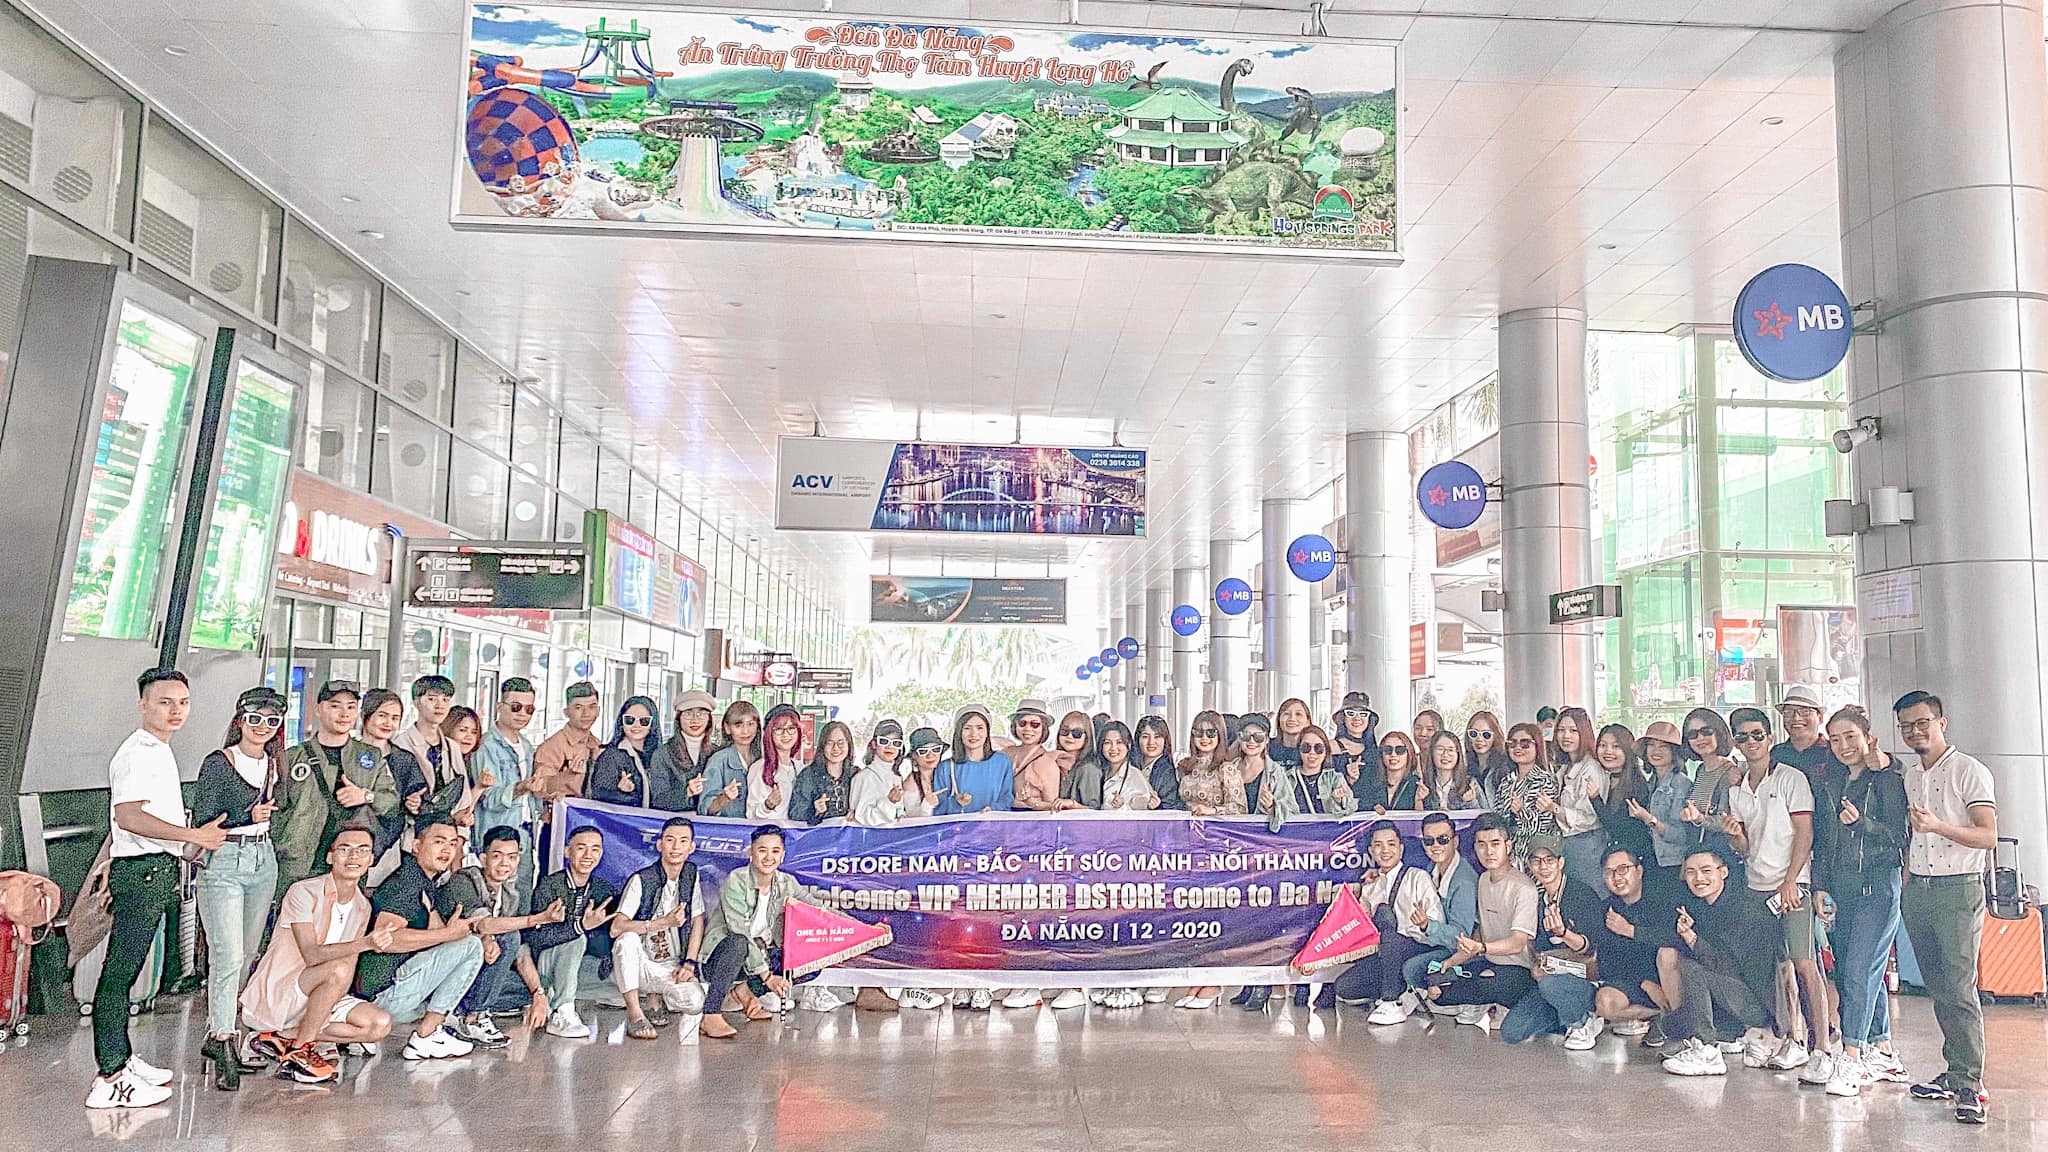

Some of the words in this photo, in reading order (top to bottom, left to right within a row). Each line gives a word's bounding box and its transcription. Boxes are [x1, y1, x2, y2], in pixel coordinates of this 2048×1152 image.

[836, 23, 880, 47] Đến
[884, 25, 918, 49] Đà
[922, 27, 984, 58] Nẵng
[678, 36, 713, 65] Ăn
[717, 41, 787, 72] Trứng
[875, 49, 919, 79] Thọ
[976, 54, 1043, 84] Huyệt
[1044, 57, 1097, 88] Long
[1798, 304, 1844, 332] MB
[792, 474, 833, 489] ACV
[1452, 485, 1481, 502] MB
[1310, 551, 1332, 562] MB
[1232, 592, 1249, 601] MB
[1184, 617, 1199, 625] MB
[822, 855, 902, 874] DSTORE
[909, 855, 958, 873] NAM
[976, 847, 1022, 873] BẮC
[1080, 849, 1122, 872] SỨC
[1129, 854, 1191, 876] MẠNH
[1210, 847, 1248, 871] NỐI
[1253, 850, 1323, 871] THÀNH
[1329, 848, 1376, 869] CÔN
[917, 884, 960, 911] VIP
[966, 883, 1068, 910] MEMBER
[1075, 883, 1166, 910] DSTORE
[1173, 886, 1241, 909] come
[1248, 883, 1272, 907] to
[1279, 882, 1311, 906] Da
[1001, 919, 1033, 941] ĐÀ
[1039, 916, 1104, 940] NẴNG
[1129, 922, 1153, 940] 12
[1171, 921, 1222, 939] 2020
